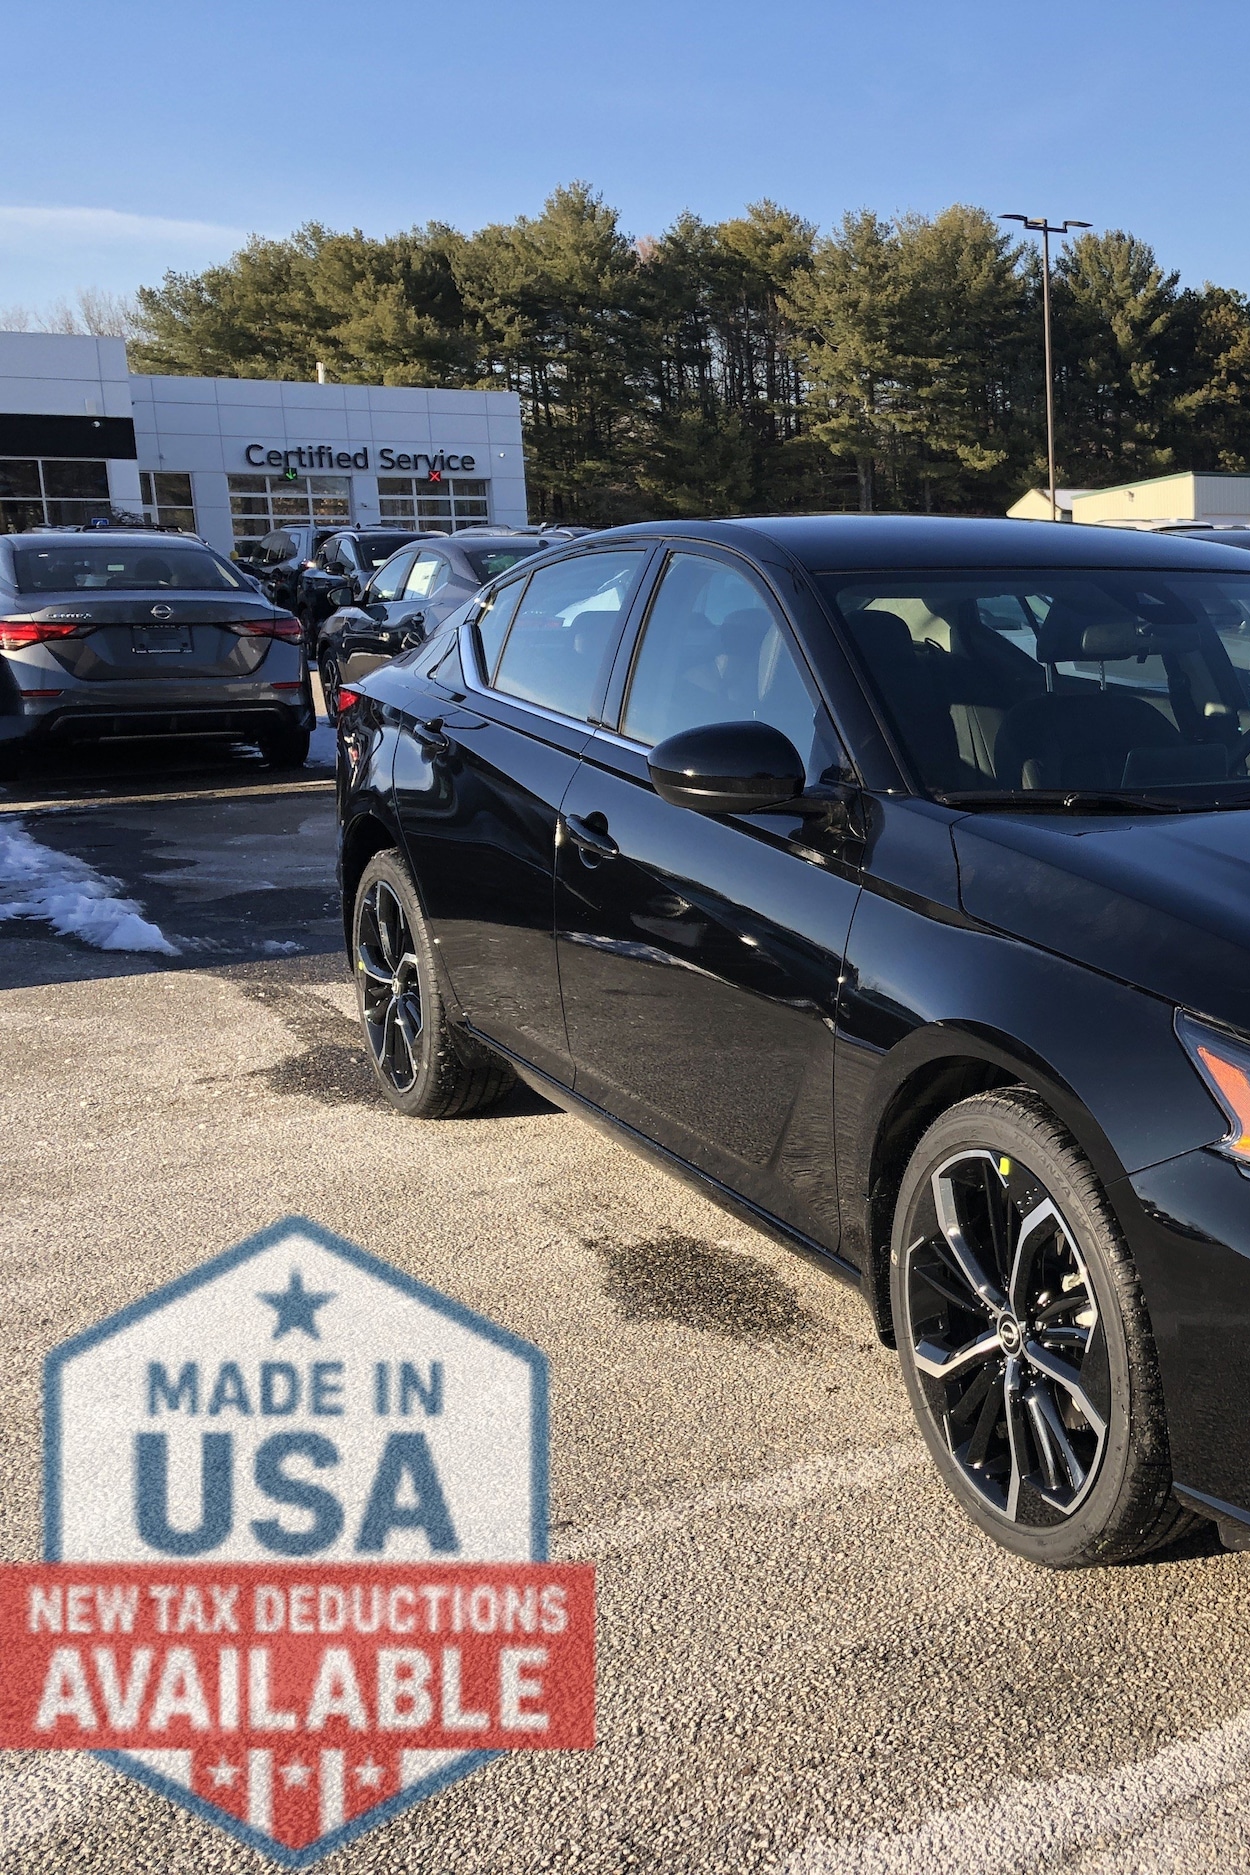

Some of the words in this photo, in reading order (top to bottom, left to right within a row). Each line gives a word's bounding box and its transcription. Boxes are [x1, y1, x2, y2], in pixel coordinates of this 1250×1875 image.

[245, 444, 369, 469] Certified
[380, 448, 476, 471] Service
[1014, 1130, 1071, 1198] TURANZA
